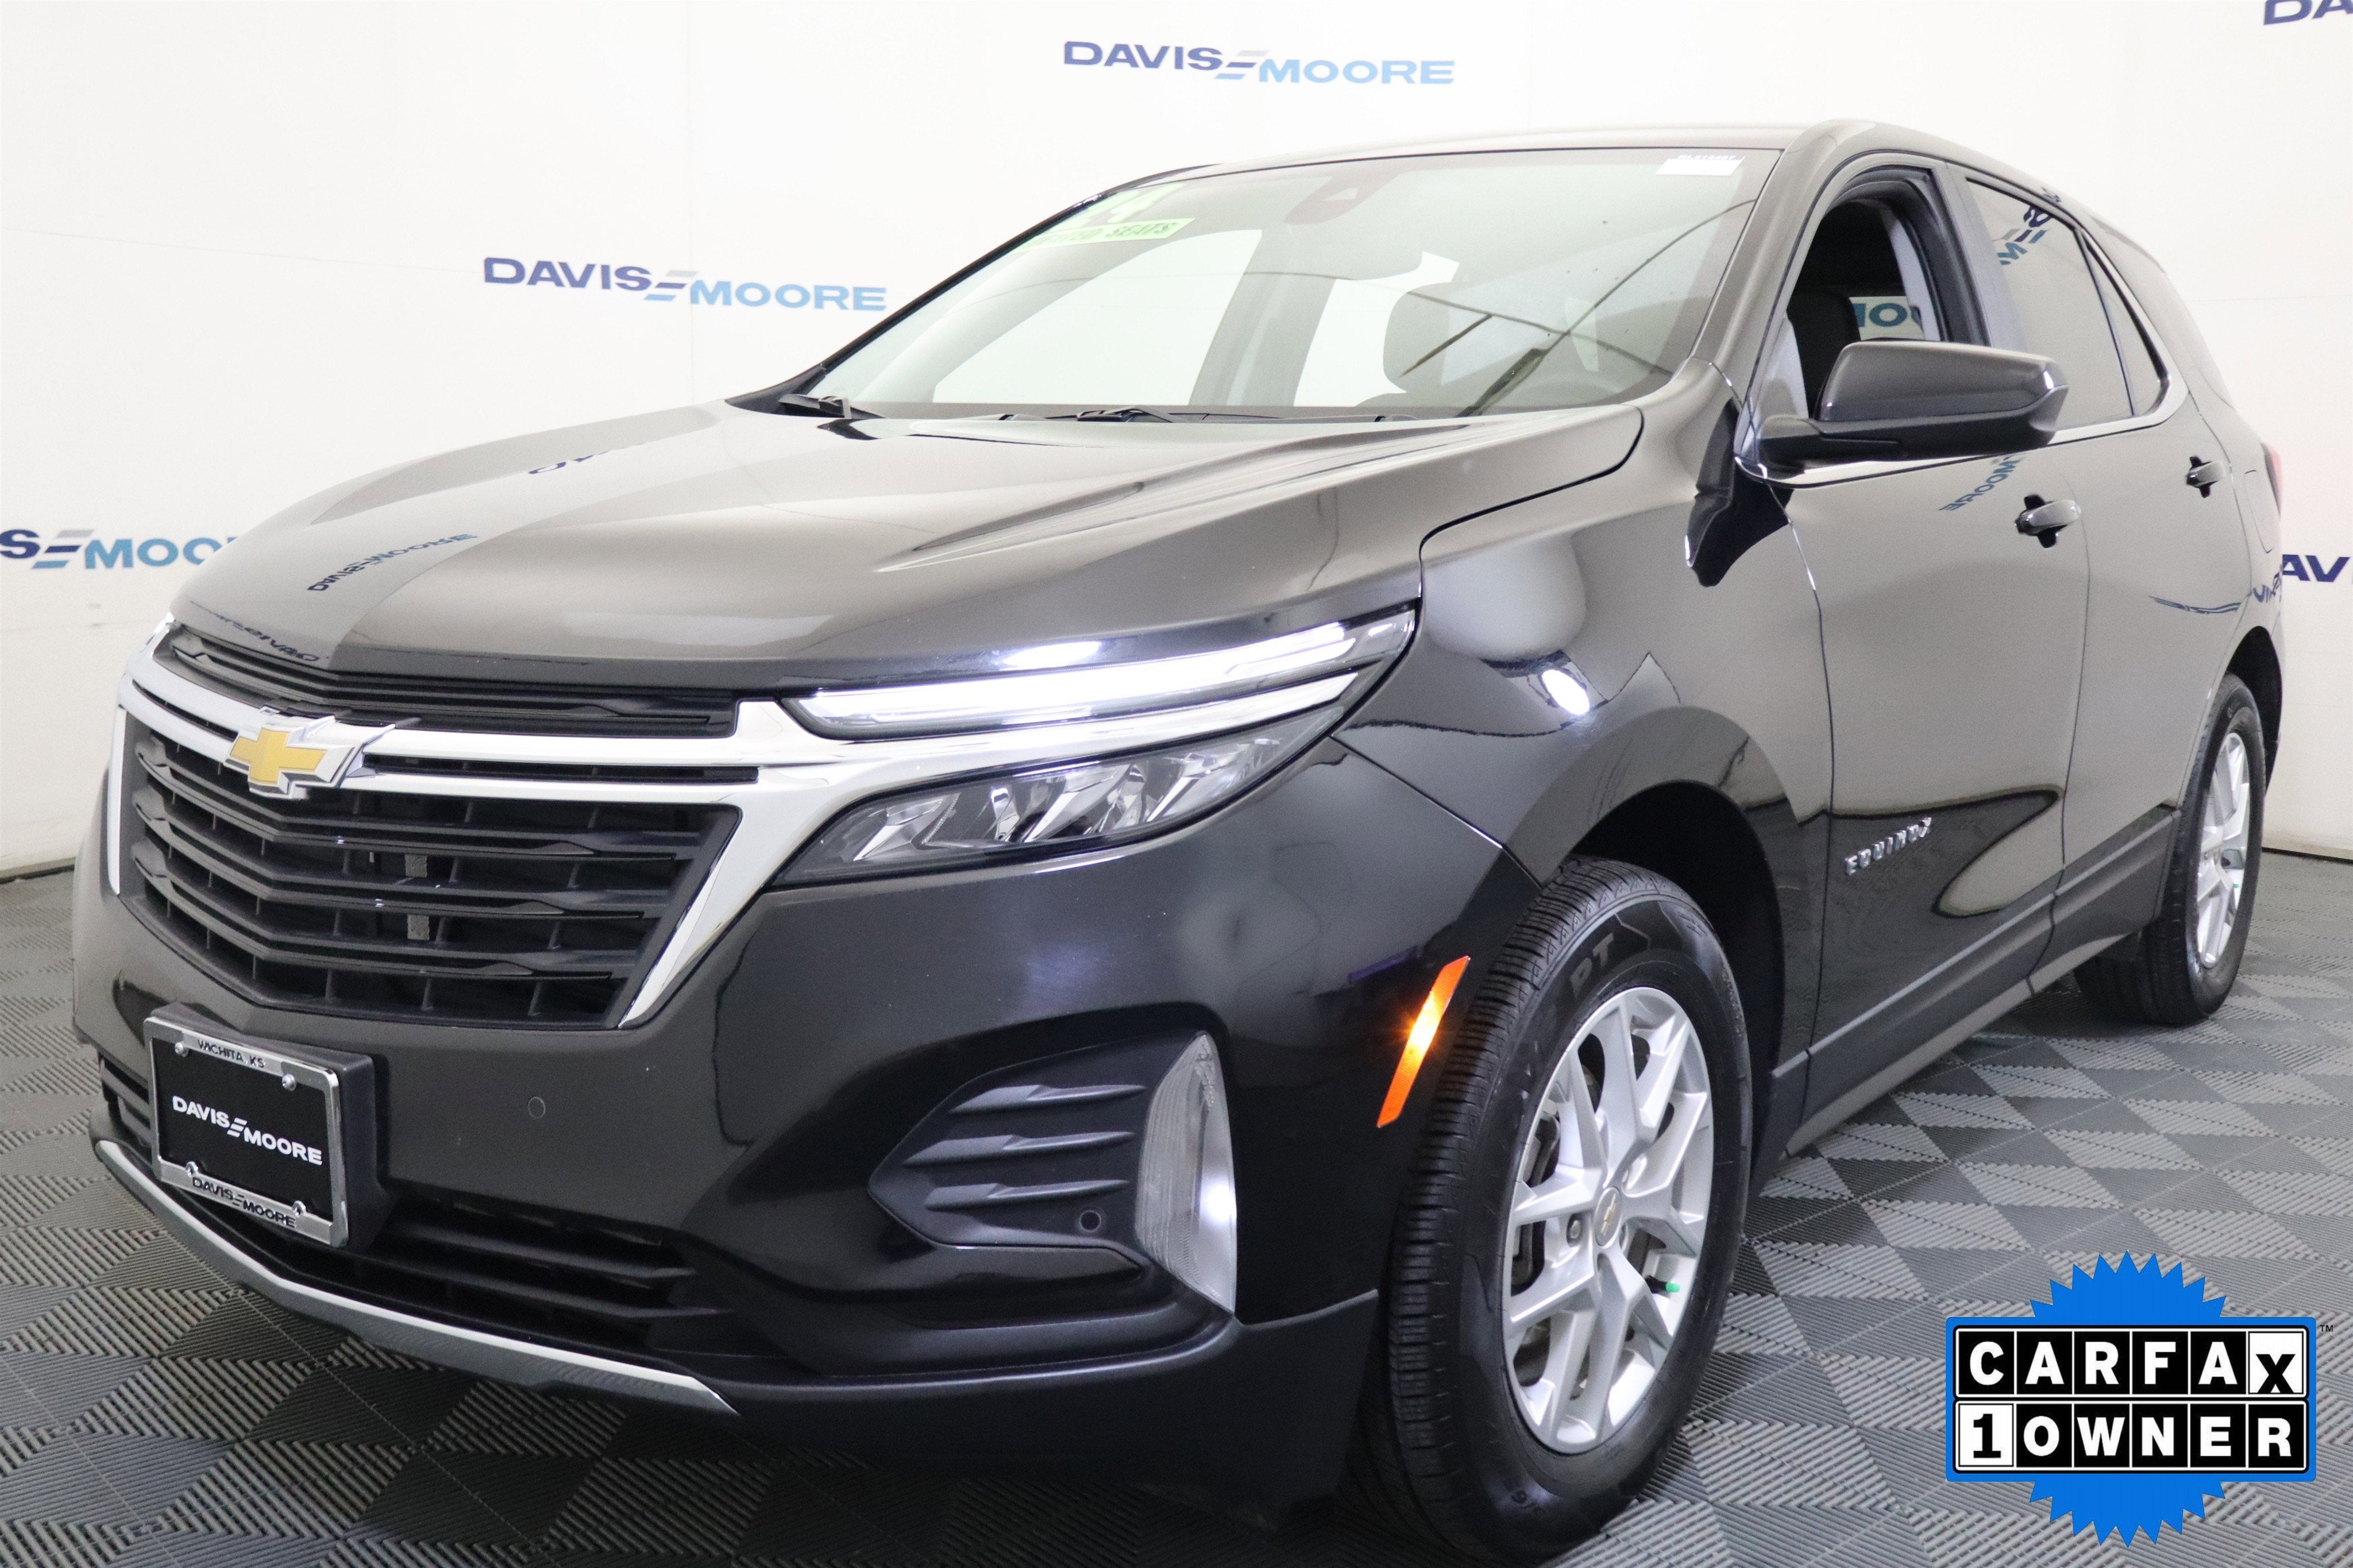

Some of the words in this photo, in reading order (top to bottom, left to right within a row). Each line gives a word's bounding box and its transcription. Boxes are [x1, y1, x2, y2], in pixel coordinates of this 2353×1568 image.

[1064, 41, 1223, 70] DAVIS
[1259, 59, 1455, 84] MOORE
[484, 257, 651, 292] DAVIS
[689, 280, 887, 311] MOORE
[84, 536, 237, 569] MOO
[1845, 817, 1932, 876] EQUINOX
[249, 1055, 265, 1068] KS
[172, 1095, 230, 1128] DAVIS
[244, 1127, 323, 1166] MOORE
[192, 1177, 233, 1200] DAVIS
[243, 1199, 296, 1229] MOORE
